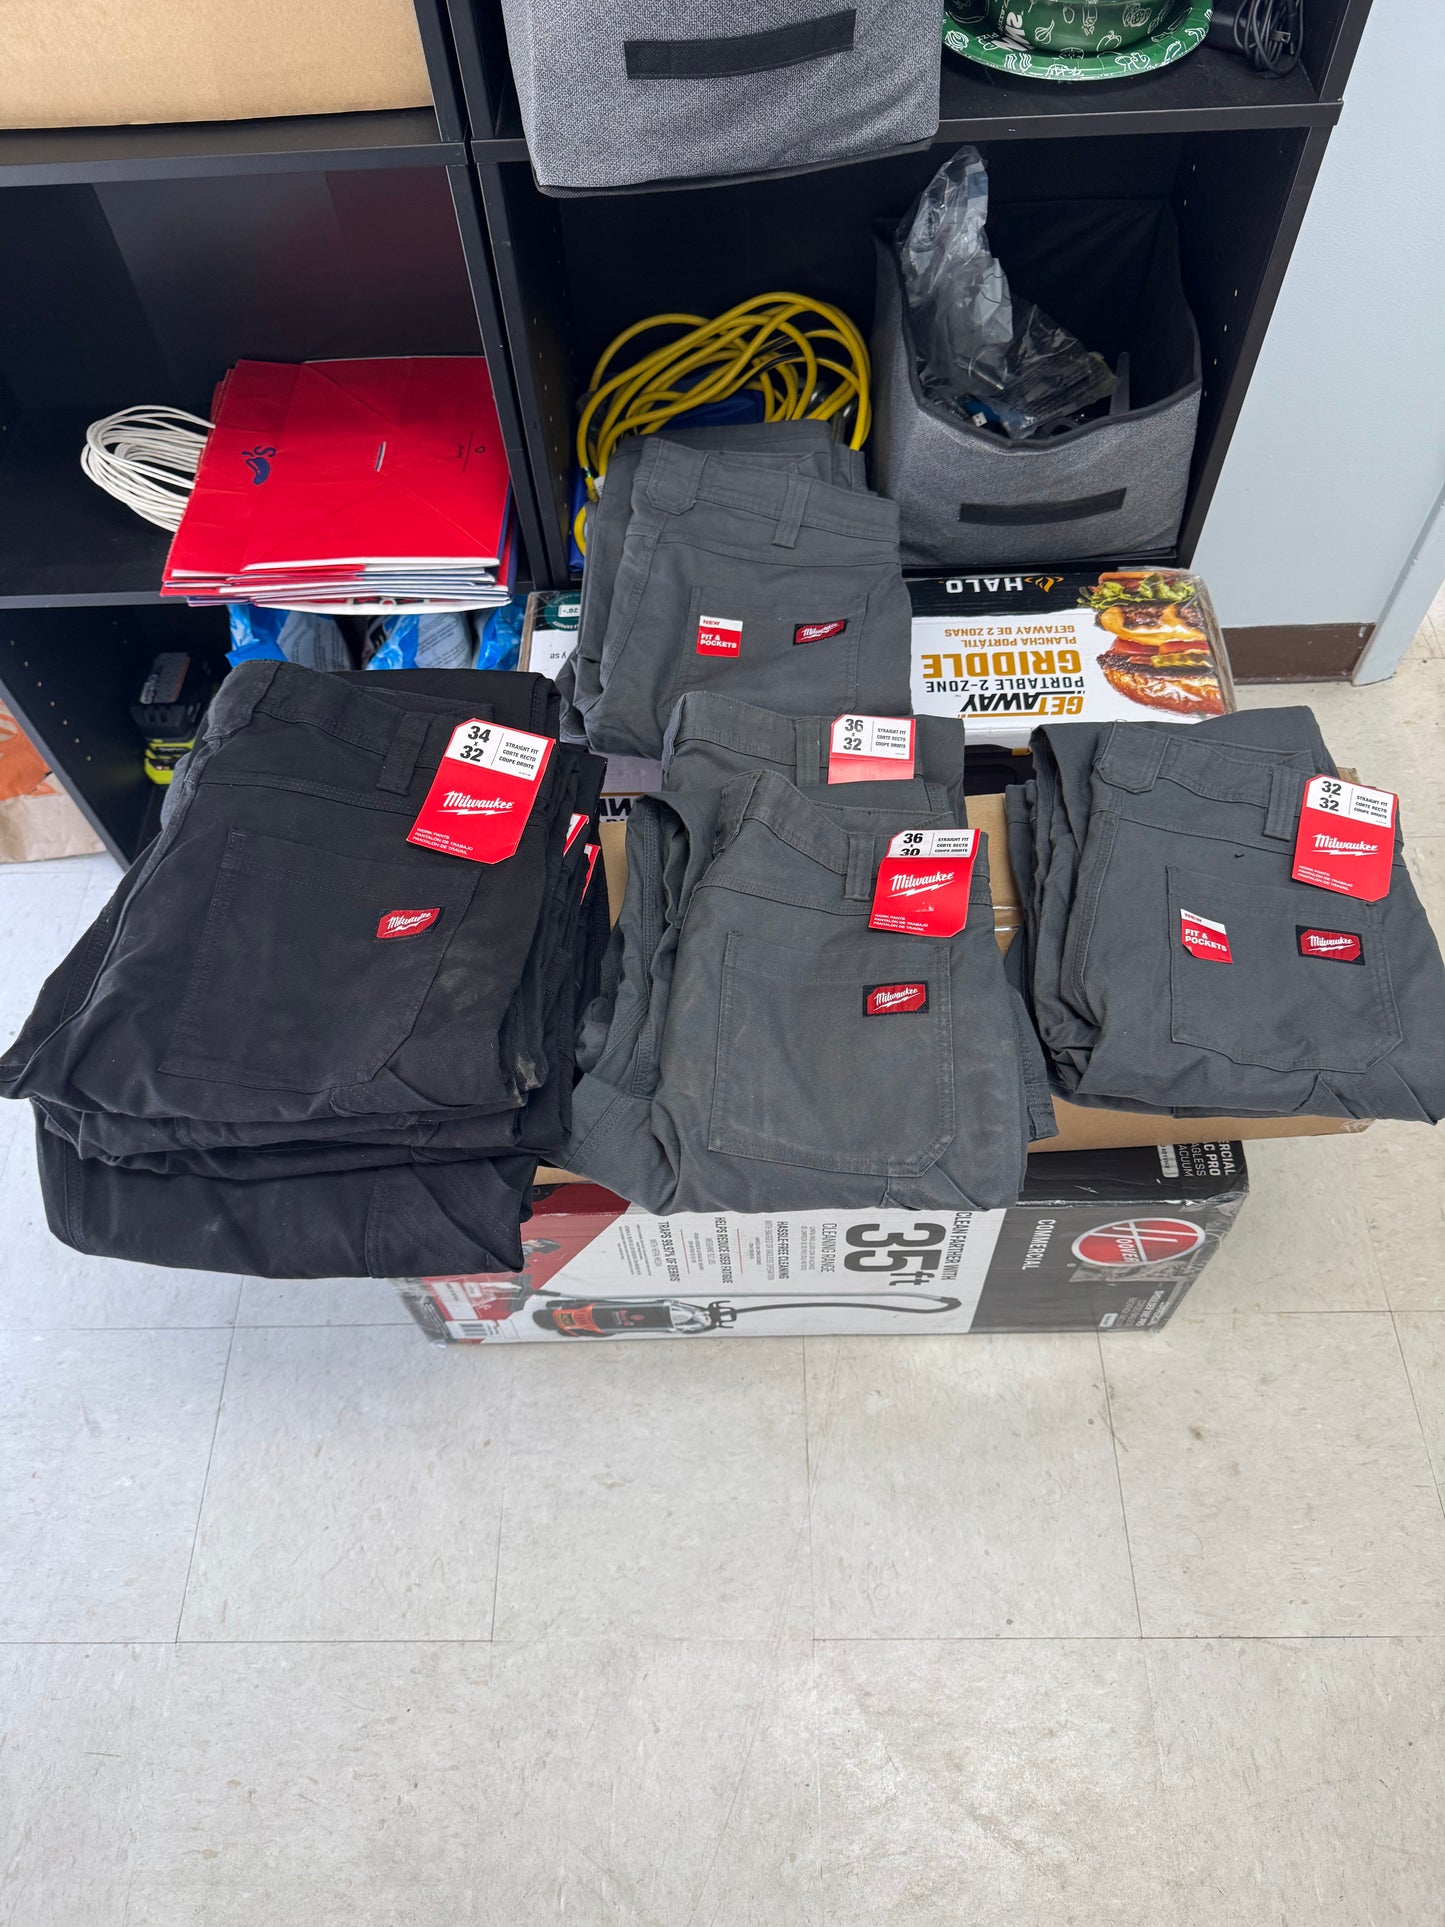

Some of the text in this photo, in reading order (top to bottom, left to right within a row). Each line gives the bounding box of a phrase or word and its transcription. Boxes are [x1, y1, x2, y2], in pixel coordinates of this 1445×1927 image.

[944, 577, 1024, 594] HALO
[801, 622, 840, 637] Milwaukee
[944, 625, 1075, 637] GETAWAY DE 2 ZONAS
[700, 640, 737, 648] POCKETS
[961, 636, 1077, 650] PLANCHA PORTÁTIL
[921, 650, 1082, 679] GRIDDLE
[926, 676, 1084, 693] PORTABLE 2-ZONE
[960, 691, 1084, 717] GETAWAY
[844, 718, 864, 732] 36
[468, 726, 491, 743] 34
[505, 742, 530, 752] STRAIGHT
[843, 737, 862, 751] 32
[460, 745, 484, 762] 32
[502, 750, 536, 762] CORTE RECTO
[499, 756, 534, 770] COUPE DROITE
[1321, 781, 1342, 796] 32
[443, 790, 514, 809] Milwaukee
[1319, 797, 1339, 812] 32
[1356, 796, 1380, 804] STRAIGHT
[450, 842, 474, 850] TRABAJO
[903, 833, 924, 844] 36
[1312, 833, 1379, 852] Milwaukee
[448, 846, 468, 854] TRAVAIL
[900, 848, 920, 856] 30
[889, 871, 954, 892] Milwaukee
[387, 912, 432, 928] Milwaukee
[1185, 928, 1200, 936] FIT
[1185, 936, 1228, 952] POCKETS
[1309, 934, 1355, 950] Milwaukee
[876, 986, 918, 1006] Milwaukee
[1206, 1154, 1220, 1176] PRO
[658, 1222, 672, 1238] TRAPS
[662, 1239, 676, 1258] 99.97%
[714, 1216, 733, 1284] HELPS REDUCE USER FATIGUE
[777, 1221, 790, 1279] HASSLE-FREE CLEANING
[820, 1222, 838, 1272] CLEANING RANGE
[941, 1212, 972, 1280] CLEAN FARTHER WITH
[1022, 1219, 1056, 1270] COMMERCIAL
